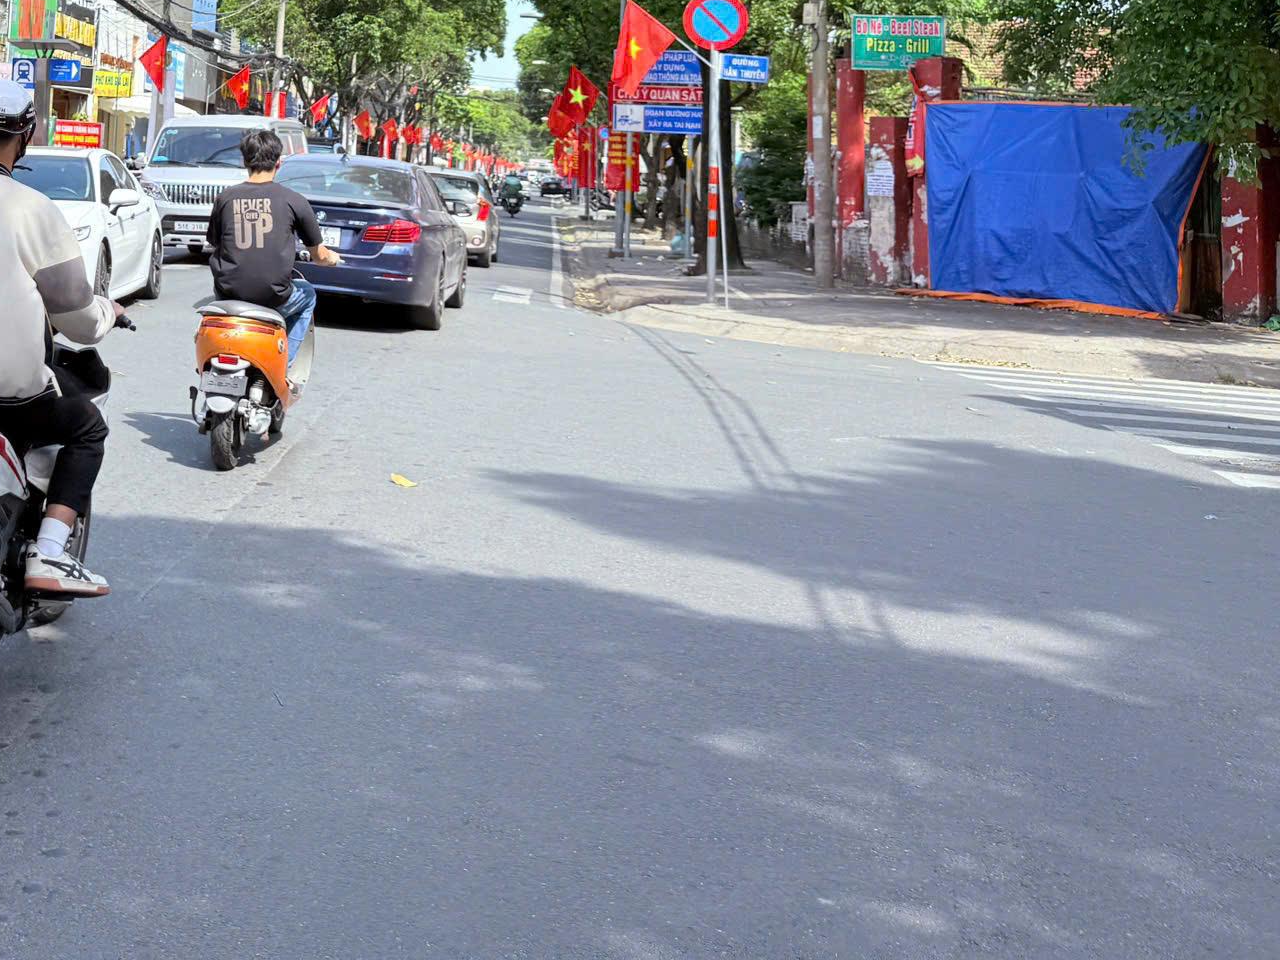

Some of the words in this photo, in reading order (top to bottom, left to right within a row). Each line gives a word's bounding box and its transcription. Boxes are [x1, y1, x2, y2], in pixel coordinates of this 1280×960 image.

[890, 19, 912, 35] Beef
[913, 20, 940, 36] Steak
[866, 37, 895, 52] Pizza
[906, 38, 929, 53] Grill
[649, 89, 679, 101] QUAN
[233, 198, 271, 214] NEVER
[245, 213, 258, 222] GIVE
[234, 213, 273, 250] UP
